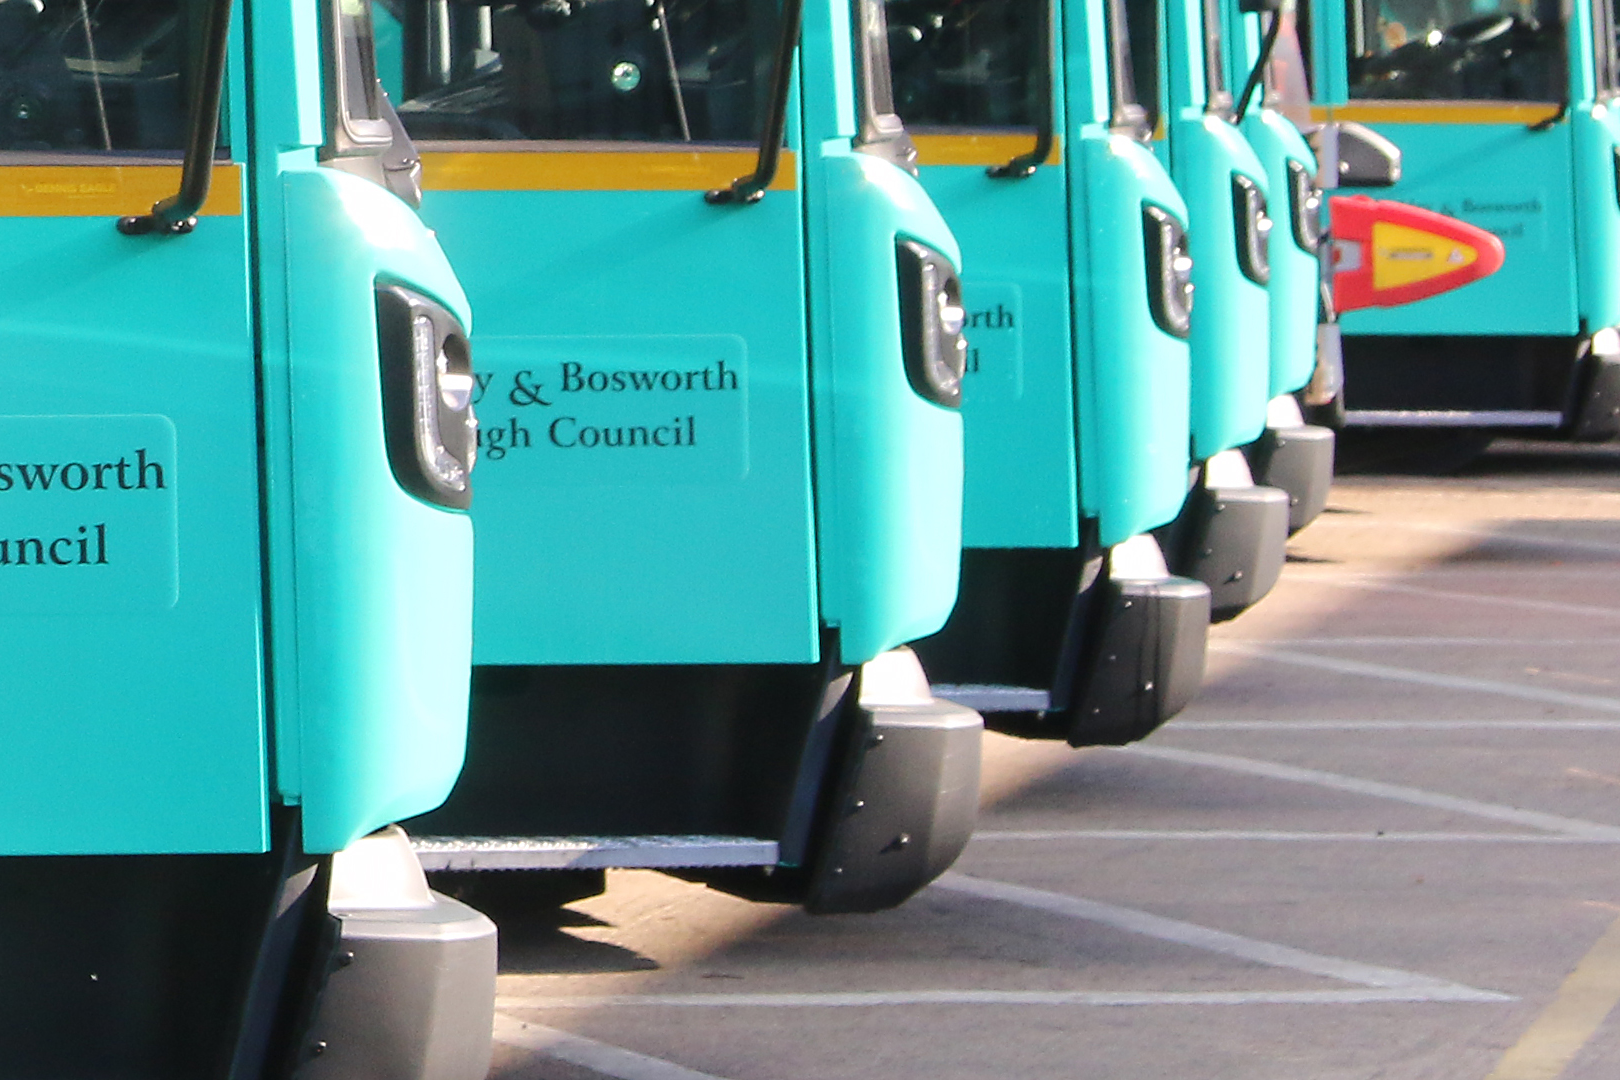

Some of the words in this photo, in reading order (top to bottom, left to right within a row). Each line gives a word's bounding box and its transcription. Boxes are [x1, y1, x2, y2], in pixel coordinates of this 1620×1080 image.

[509, 370, 552, 407] &
[560, 360, 739, 393] Bosworth
[548, 415, 696, 449] Council
